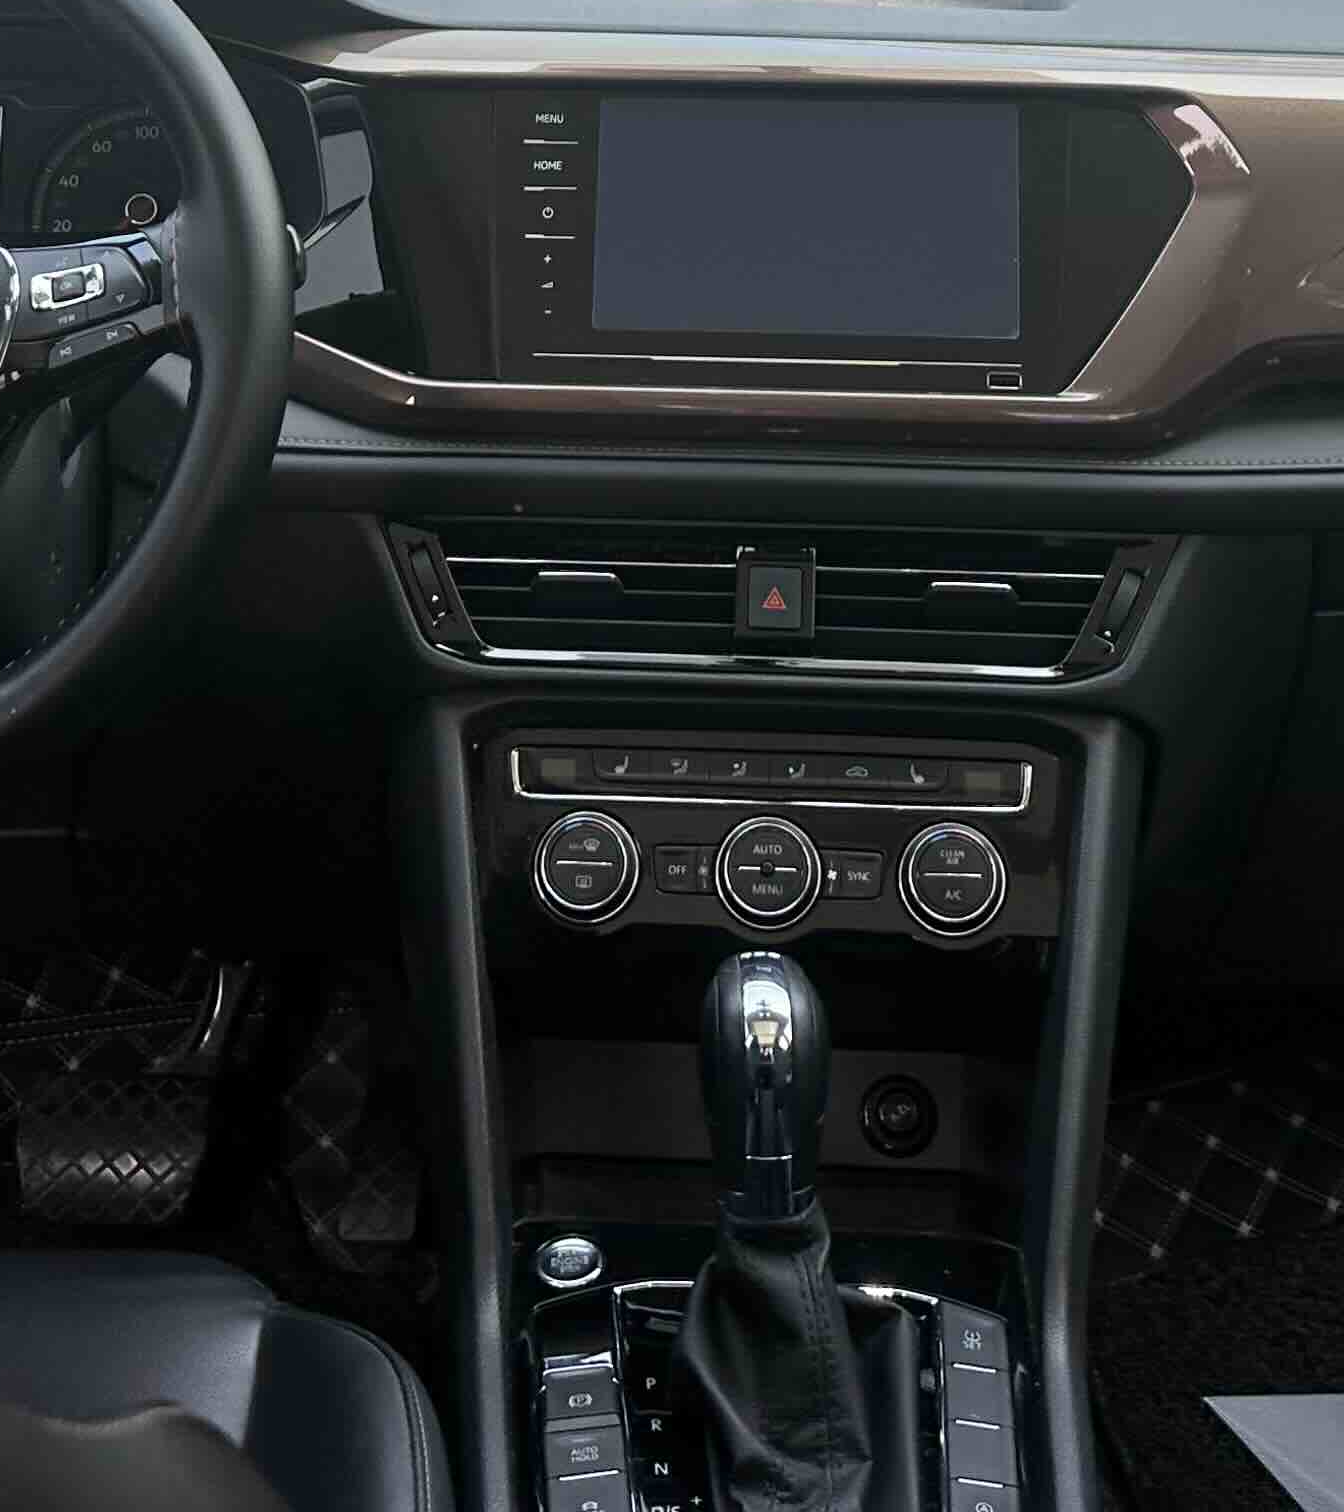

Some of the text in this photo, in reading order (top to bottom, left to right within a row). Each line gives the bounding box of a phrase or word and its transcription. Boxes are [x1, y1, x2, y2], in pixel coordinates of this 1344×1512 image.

[535, 112, 565, 125] MENU
[135, 125, 160, 139] 100
[91, 139, 113, 154] 60
[533, 159, 564, 172] HOME
[57, 173, 80, 188] 40
[52, 218, 73, 233] 20
[752, 844, 783, 856] AUTO
[667, 864, 688, 876] OFF
[752, 884, 784, 897] MENU
[645, 1376, 657, 1390] P
[650, 1418, 663, 1432] R
[654, 1463, 669, 1476] N
